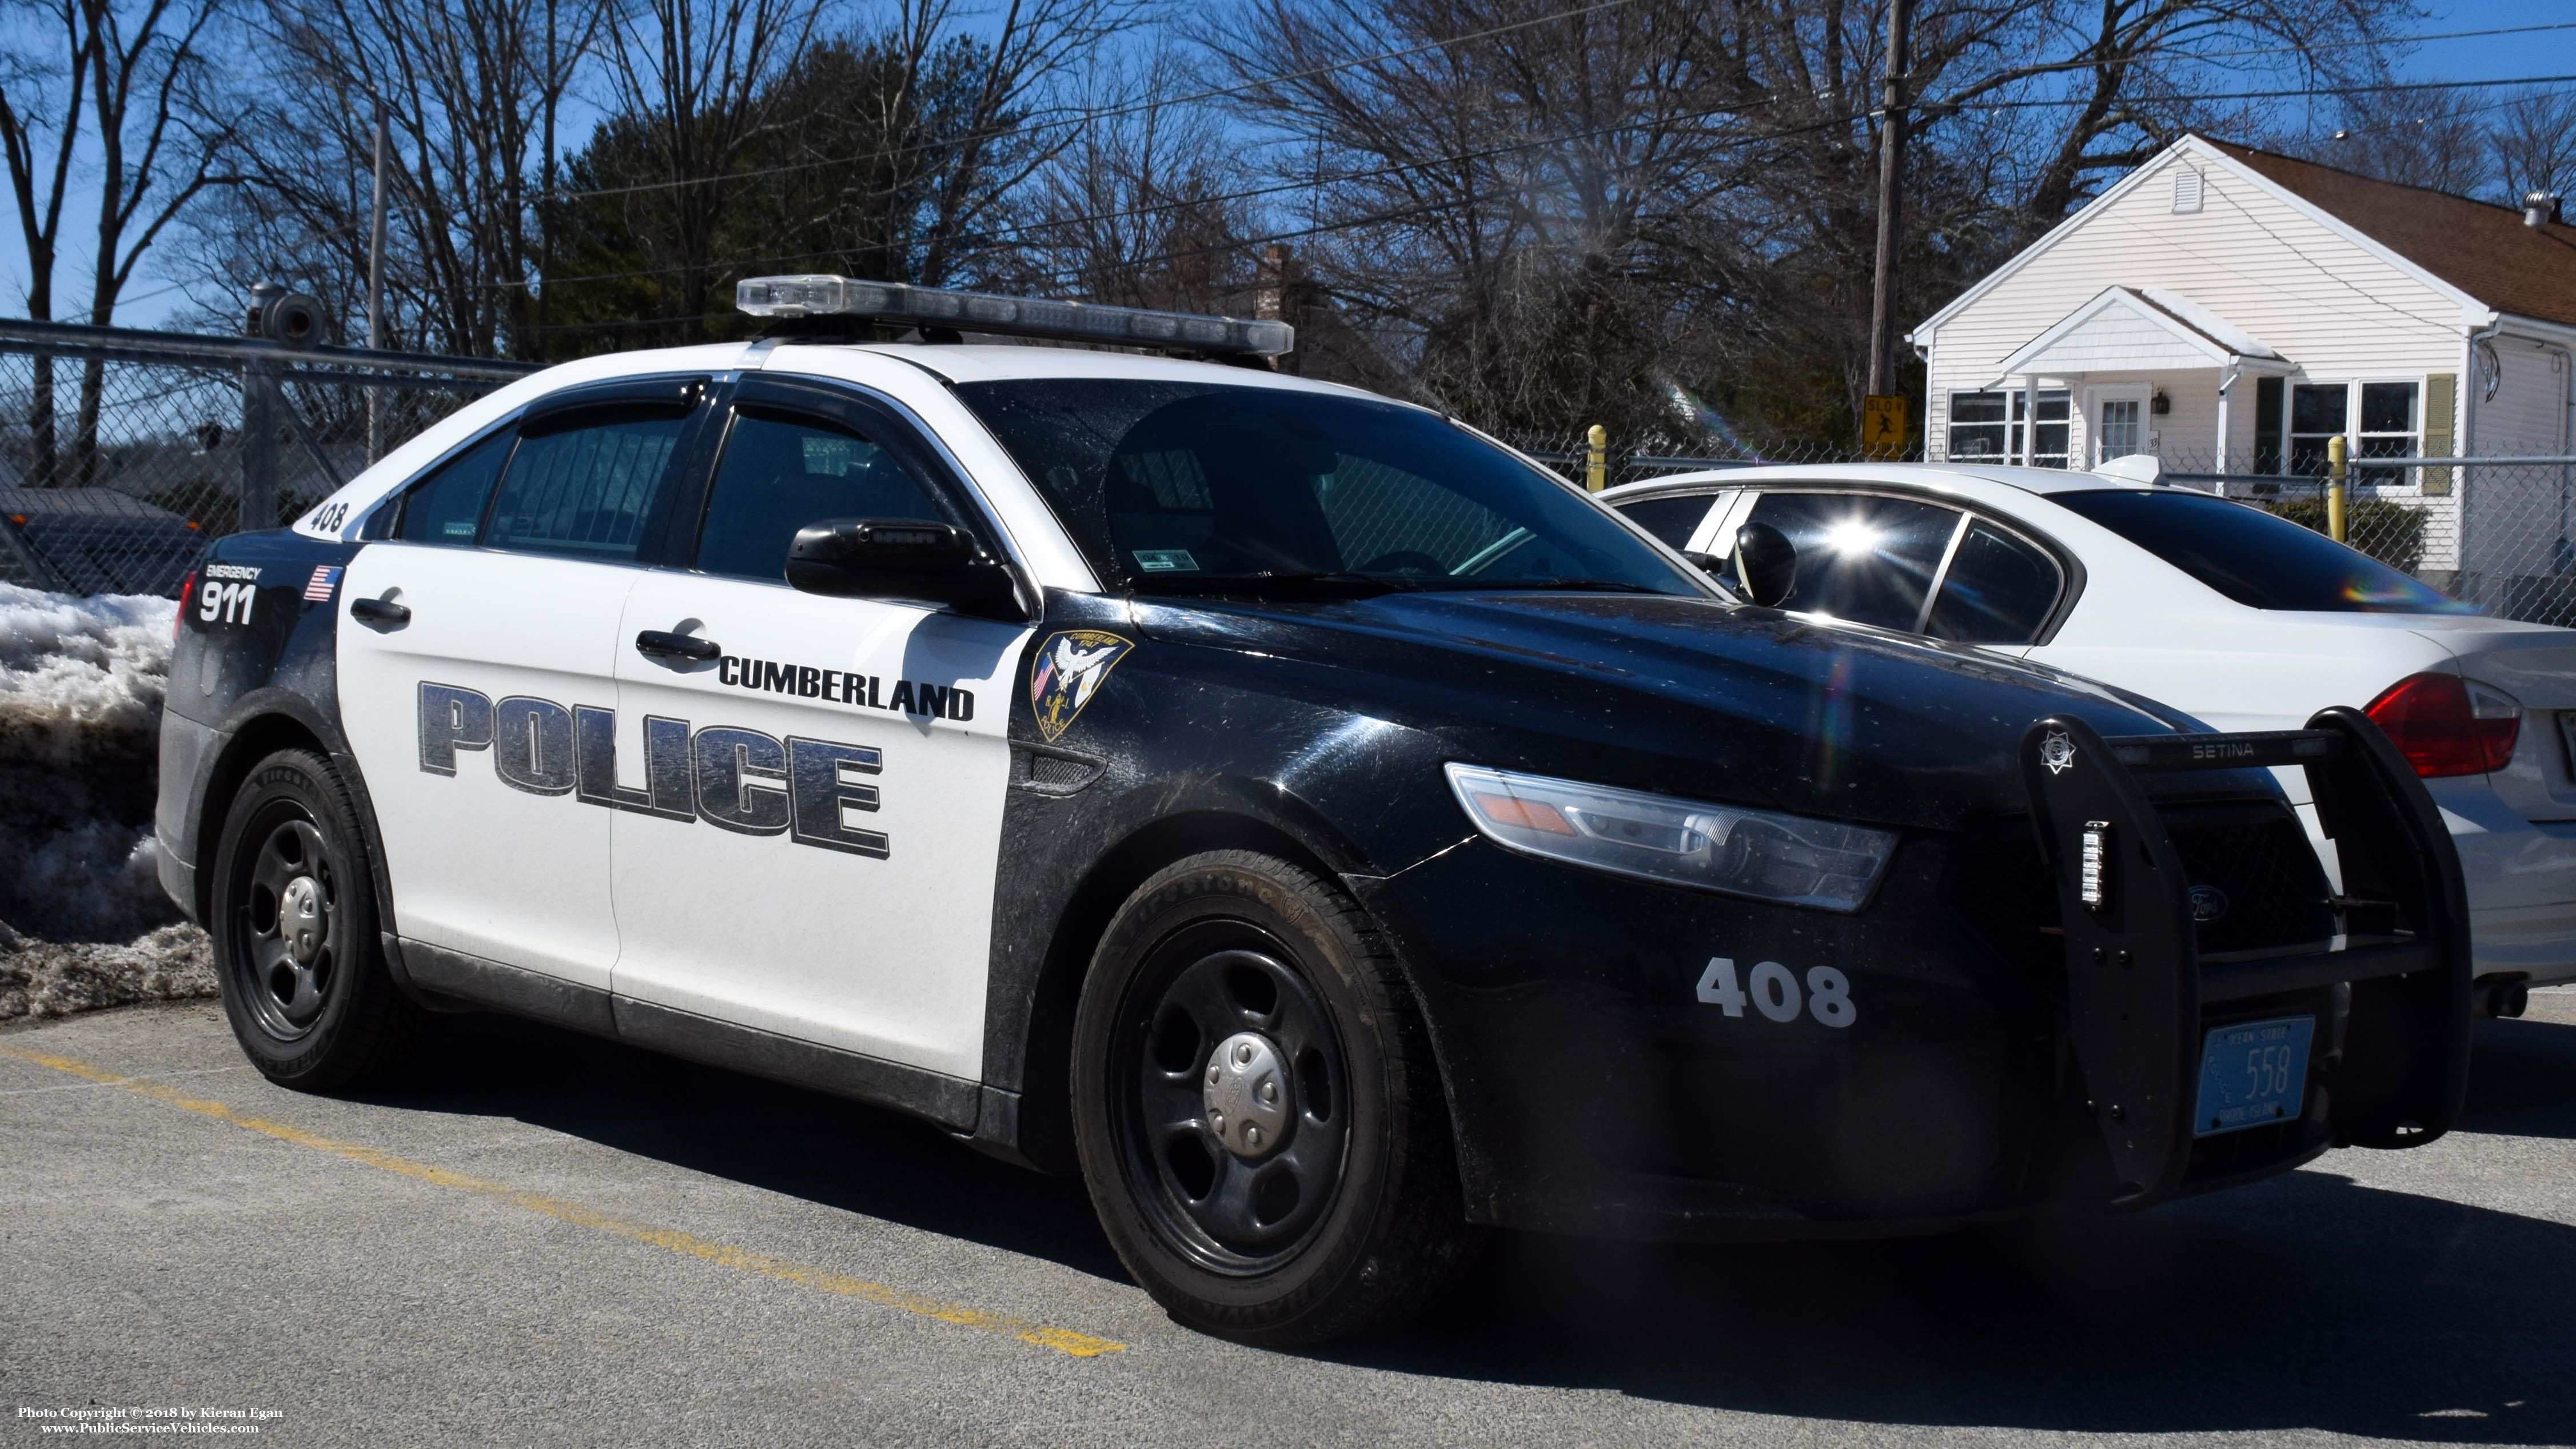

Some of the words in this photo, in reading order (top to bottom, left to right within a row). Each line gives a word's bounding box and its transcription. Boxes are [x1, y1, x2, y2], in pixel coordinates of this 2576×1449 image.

[310, 502, 349, 533] 408
[206, 564, 262, 581] EMERGENCY
[200, 581, 256, 625] 911
[1070, 633, 1119, 646] CUMBERLAND
[719, 655, 974, 722] CUMBERLAND
[1040, 716, 1066, 734] POLICE
[2192, 744, 2254, 759] SETINA
[418, 680, 890, 861] POLICE
[2191, 893, 2219, 915] Ford
[1696, 957, 1857, 1028] 408
[2260, 1028, 2287, 1041] STATE
[2208, 1055, 2232, 1103] POLICE
[2245, 1044, 2291, 1100] 558
[2219, 1107, 2246, 1121] RHODE
[2250, 1101, 2278, 1118] ISLAND
